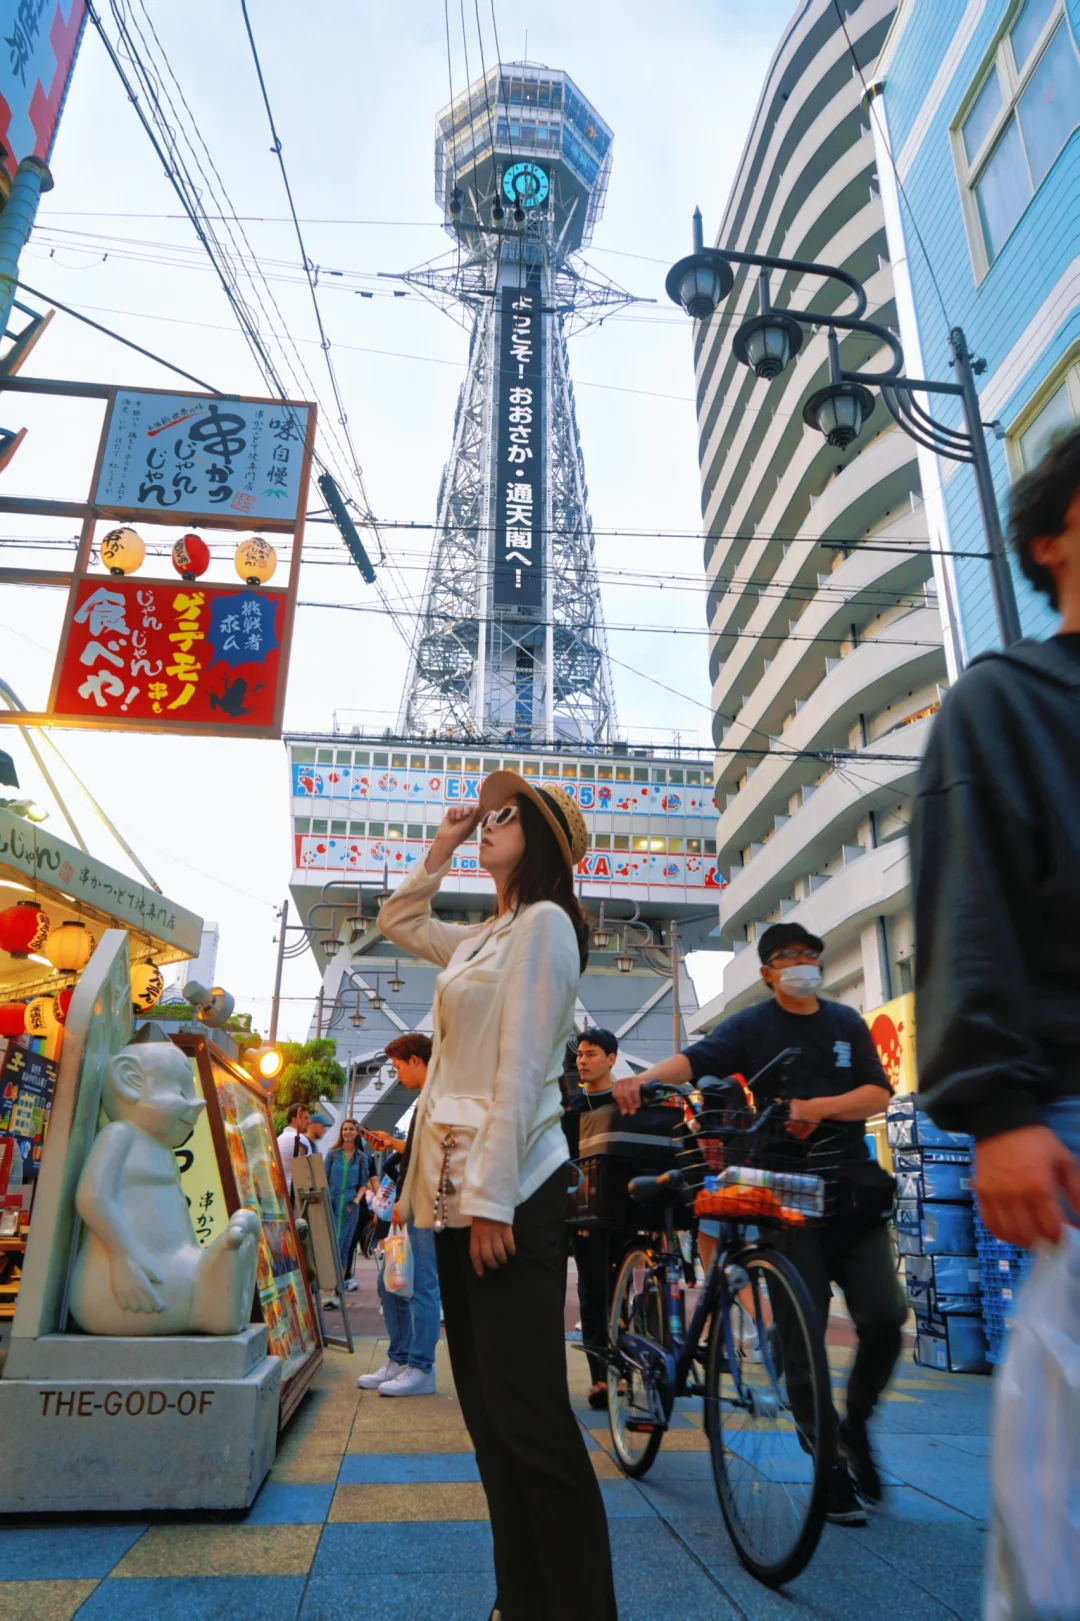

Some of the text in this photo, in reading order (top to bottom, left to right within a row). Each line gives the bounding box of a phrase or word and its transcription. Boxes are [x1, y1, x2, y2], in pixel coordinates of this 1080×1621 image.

[188, 404, 246, 503] 串かつ
[267, 413, 298, 487] 味自慢
[103, 528, 124, 559] 串かつ
[219, 614, 241, 651] 求ム
[241, 600, 264, 651] 挑戦者
[166, 591, 205, 710] ゲテモノ
[147, 681, 168, 714] 串も
[0, 828, 61, 870] じゃん
[78, 867, 176, 931] 串かつ・どて焼専門店
[39, 1390, 215, 1417] THE-GOD-OF
